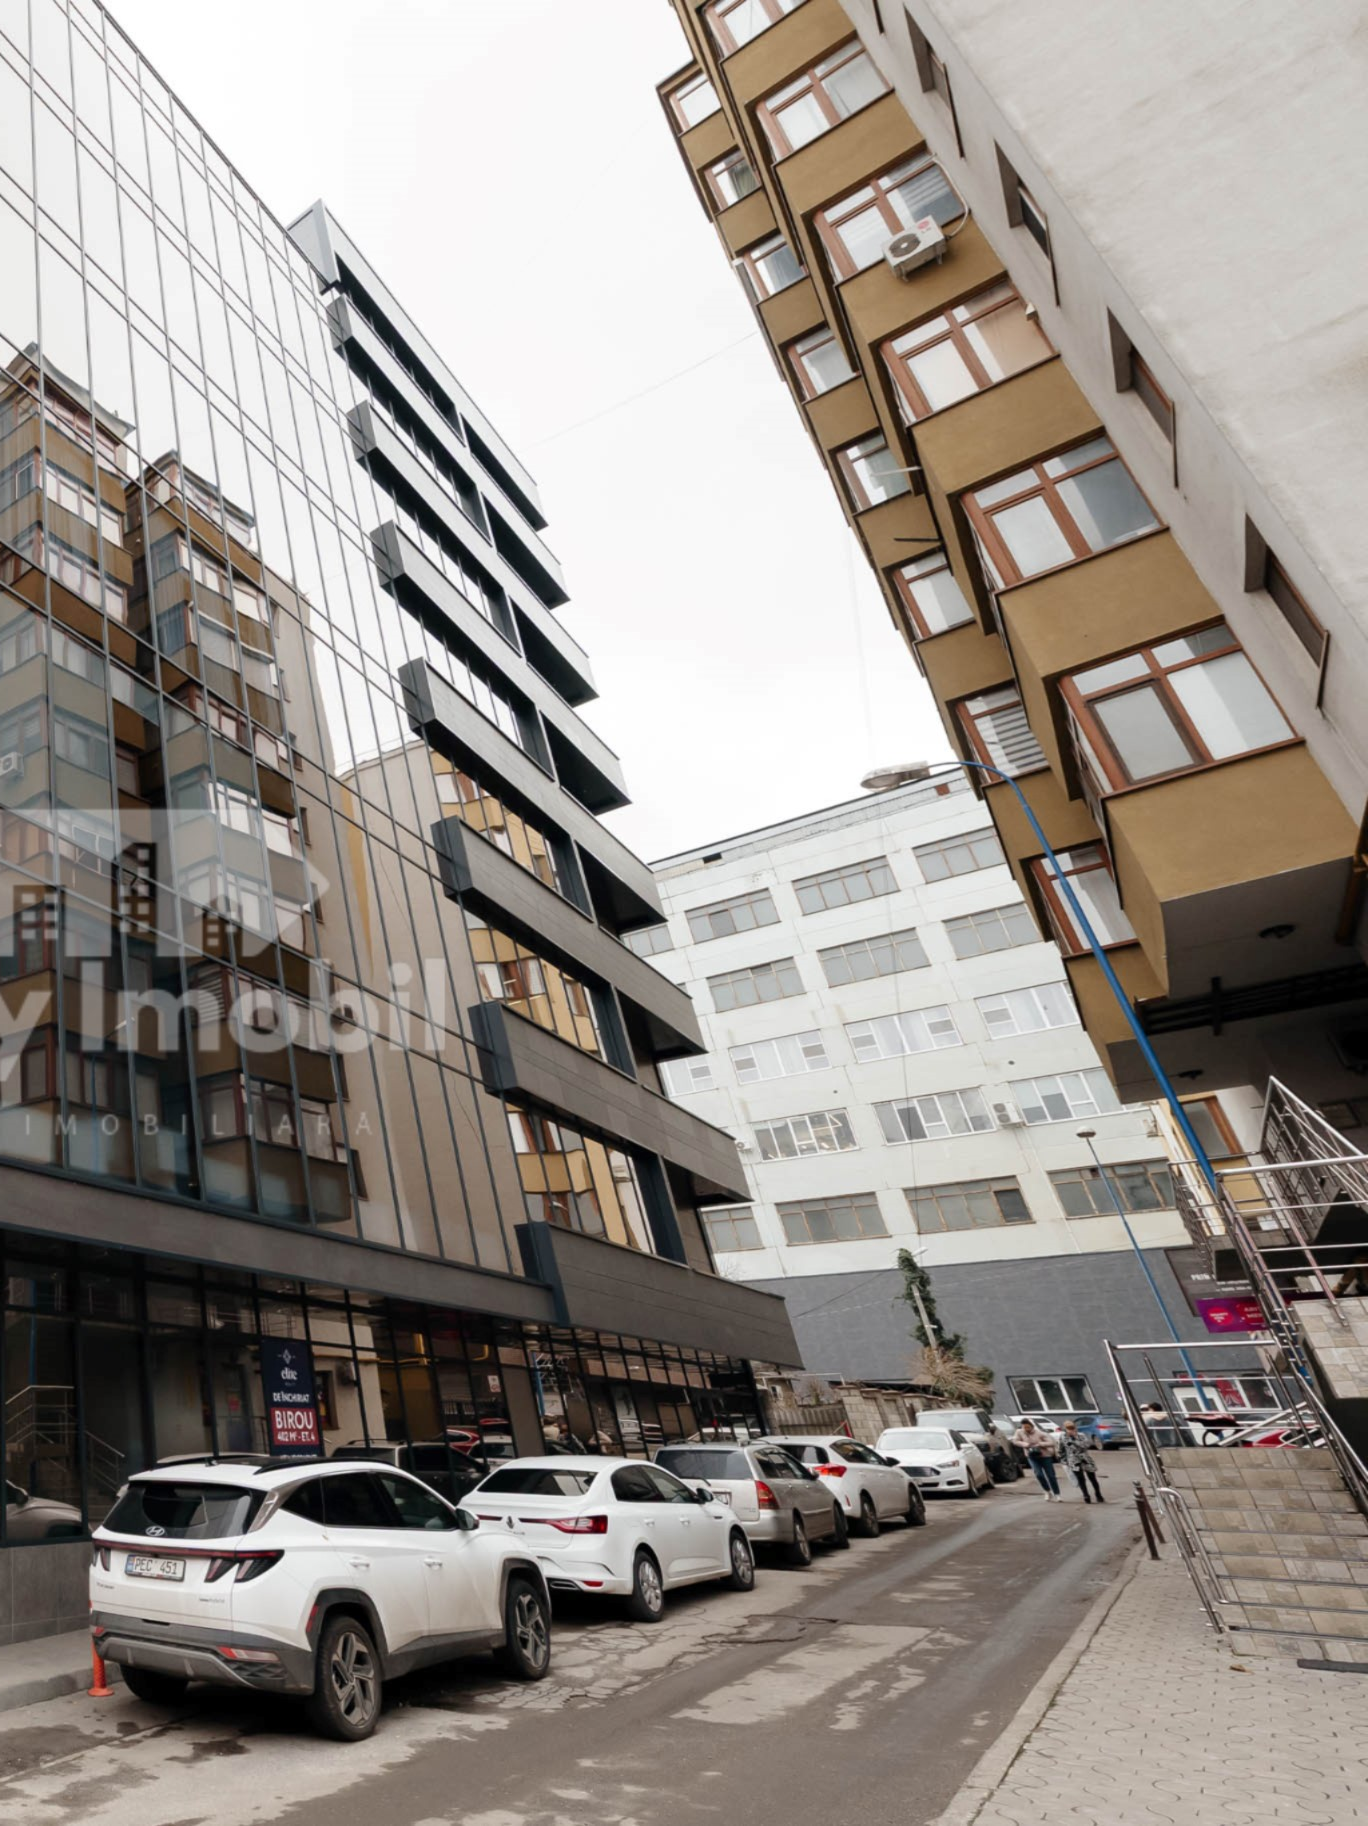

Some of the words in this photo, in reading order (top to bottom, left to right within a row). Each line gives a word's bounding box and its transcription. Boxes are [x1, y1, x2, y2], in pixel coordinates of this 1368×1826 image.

[275, 1410, 314, 1430] BIROU
[134, 1558, 152, 1572] PEC
[159, 1561, 177, 1575] 451
